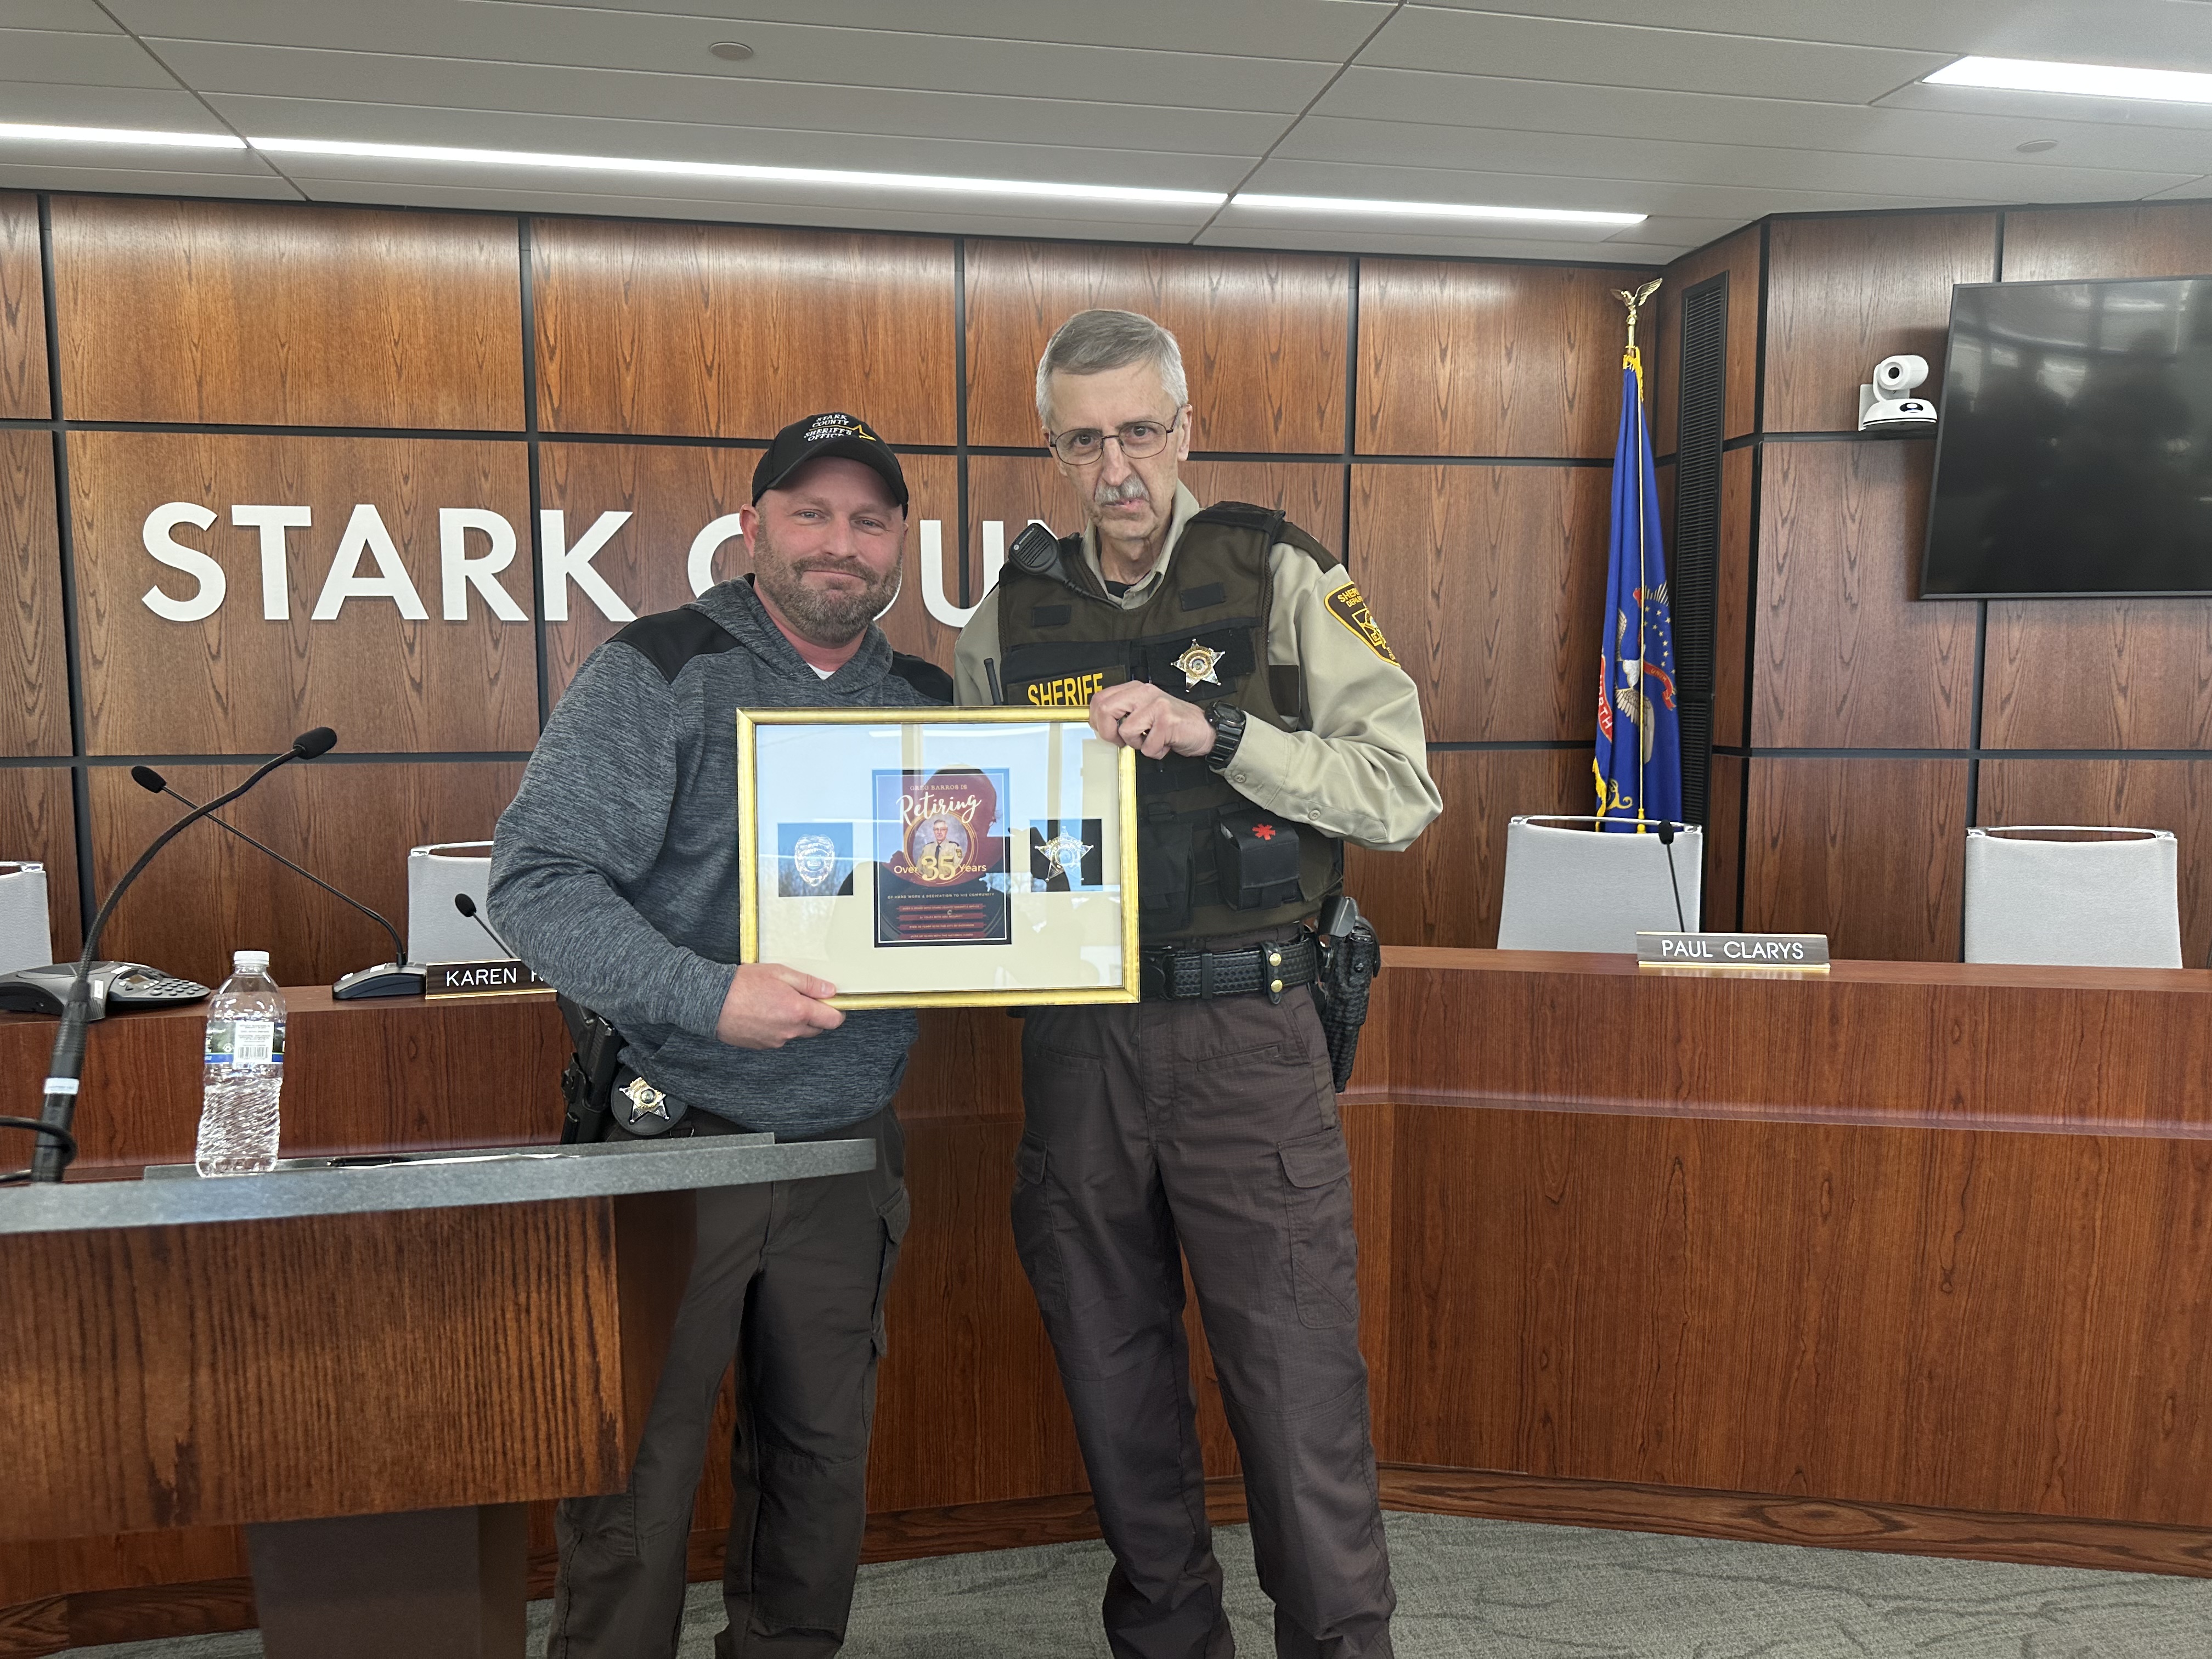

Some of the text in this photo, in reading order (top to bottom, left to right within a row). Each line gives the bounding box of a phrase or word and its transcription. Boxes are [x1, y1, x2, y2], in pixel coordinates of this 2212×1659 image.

[812, 419, 849, 427] COUNTY
[816, 414, 847, 422] STARK
[804, 427, 852, 438] SHERIFF'S
[142, 501, 637, 622] STARK
[1028, 673, 1103, 706] SHERIFF
[896, 791, 981, 826] Retiring
[894, 855, 987, 881] Over 35 Years
[1661, 940, 1804, 960] PAUL CLARYS
[446, 968, 517, 986] KAREN
